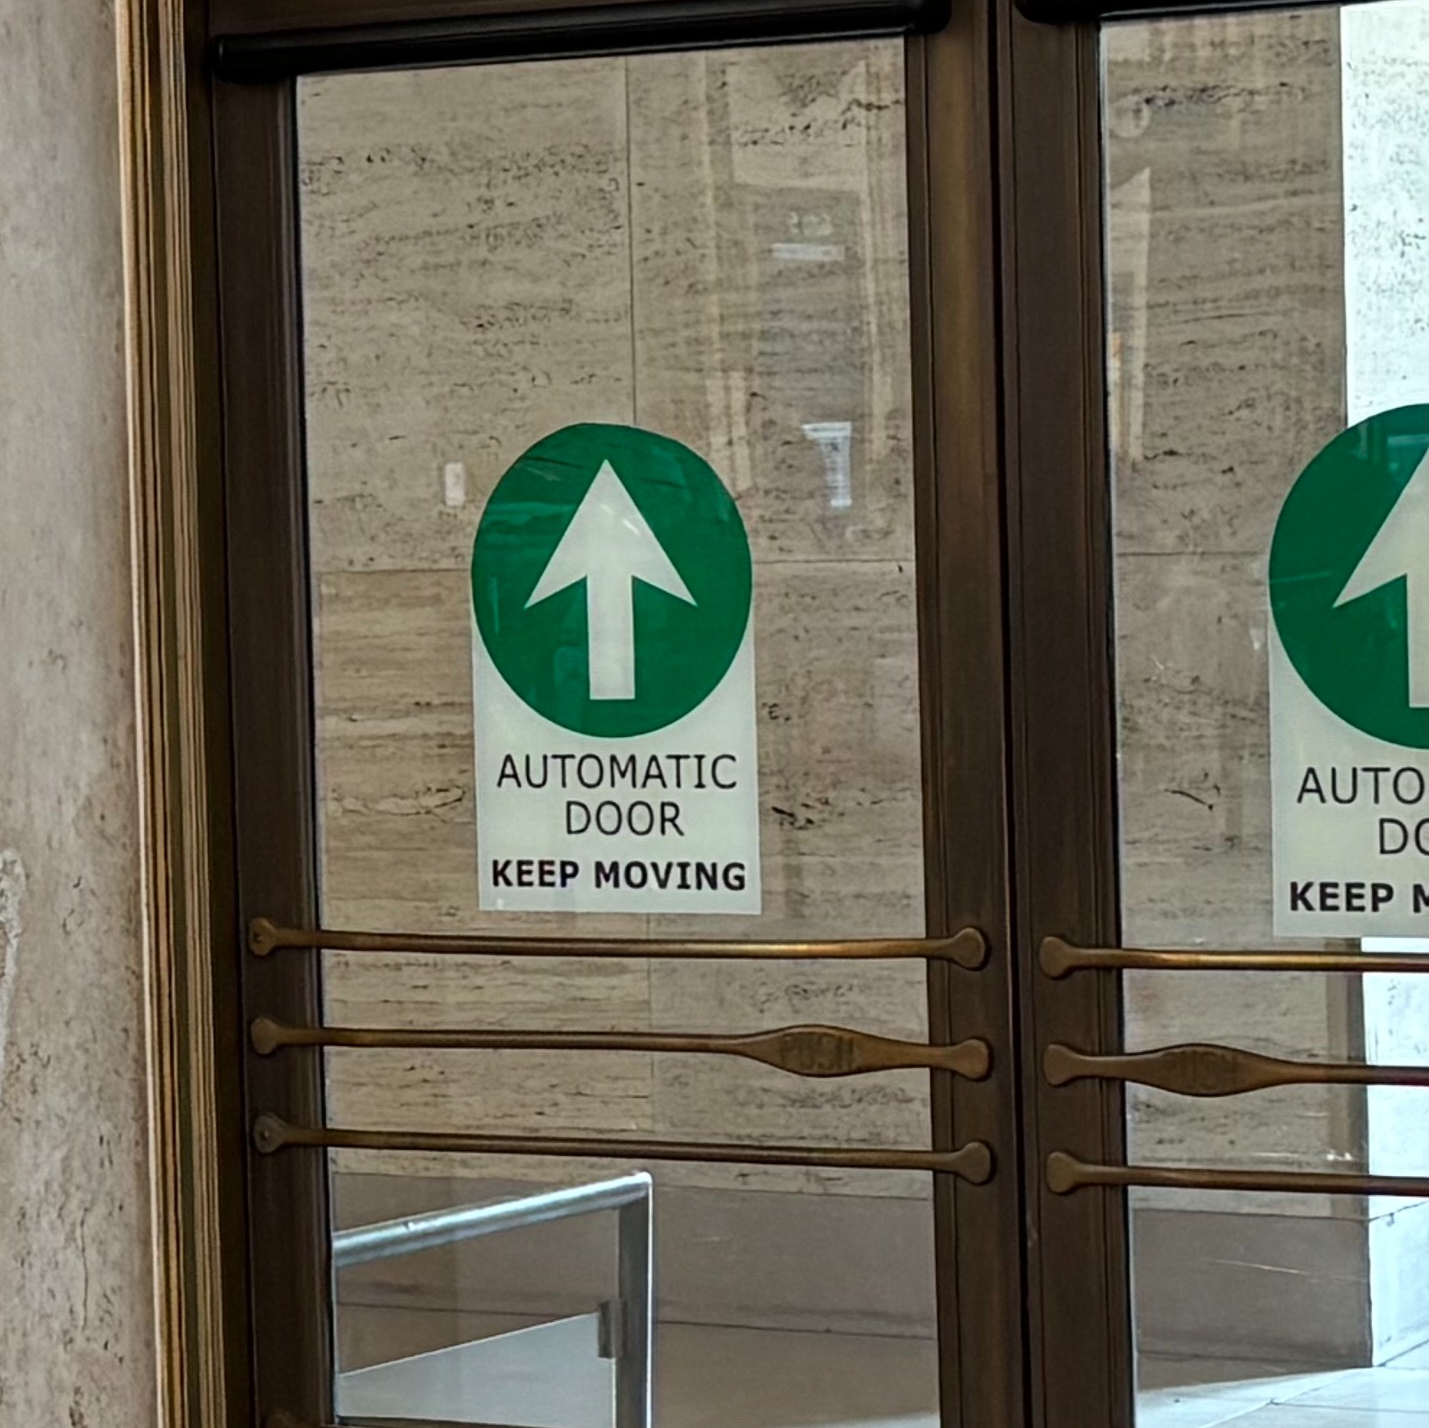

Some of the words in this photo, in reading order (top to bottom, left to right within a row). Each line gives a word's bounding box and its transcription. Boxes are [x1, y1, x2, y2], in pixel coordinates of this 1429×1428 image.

[496, 753, 737, 790] AUTOMATIC
[565, 799, 685, 837] DOOR
[492, 859, 580, 889] KEEP
[594, 860, 746, 892] MOVING
[1289, 881, 1394, 913] KEEP
[778, 1031, 855, 1070] PUSH
